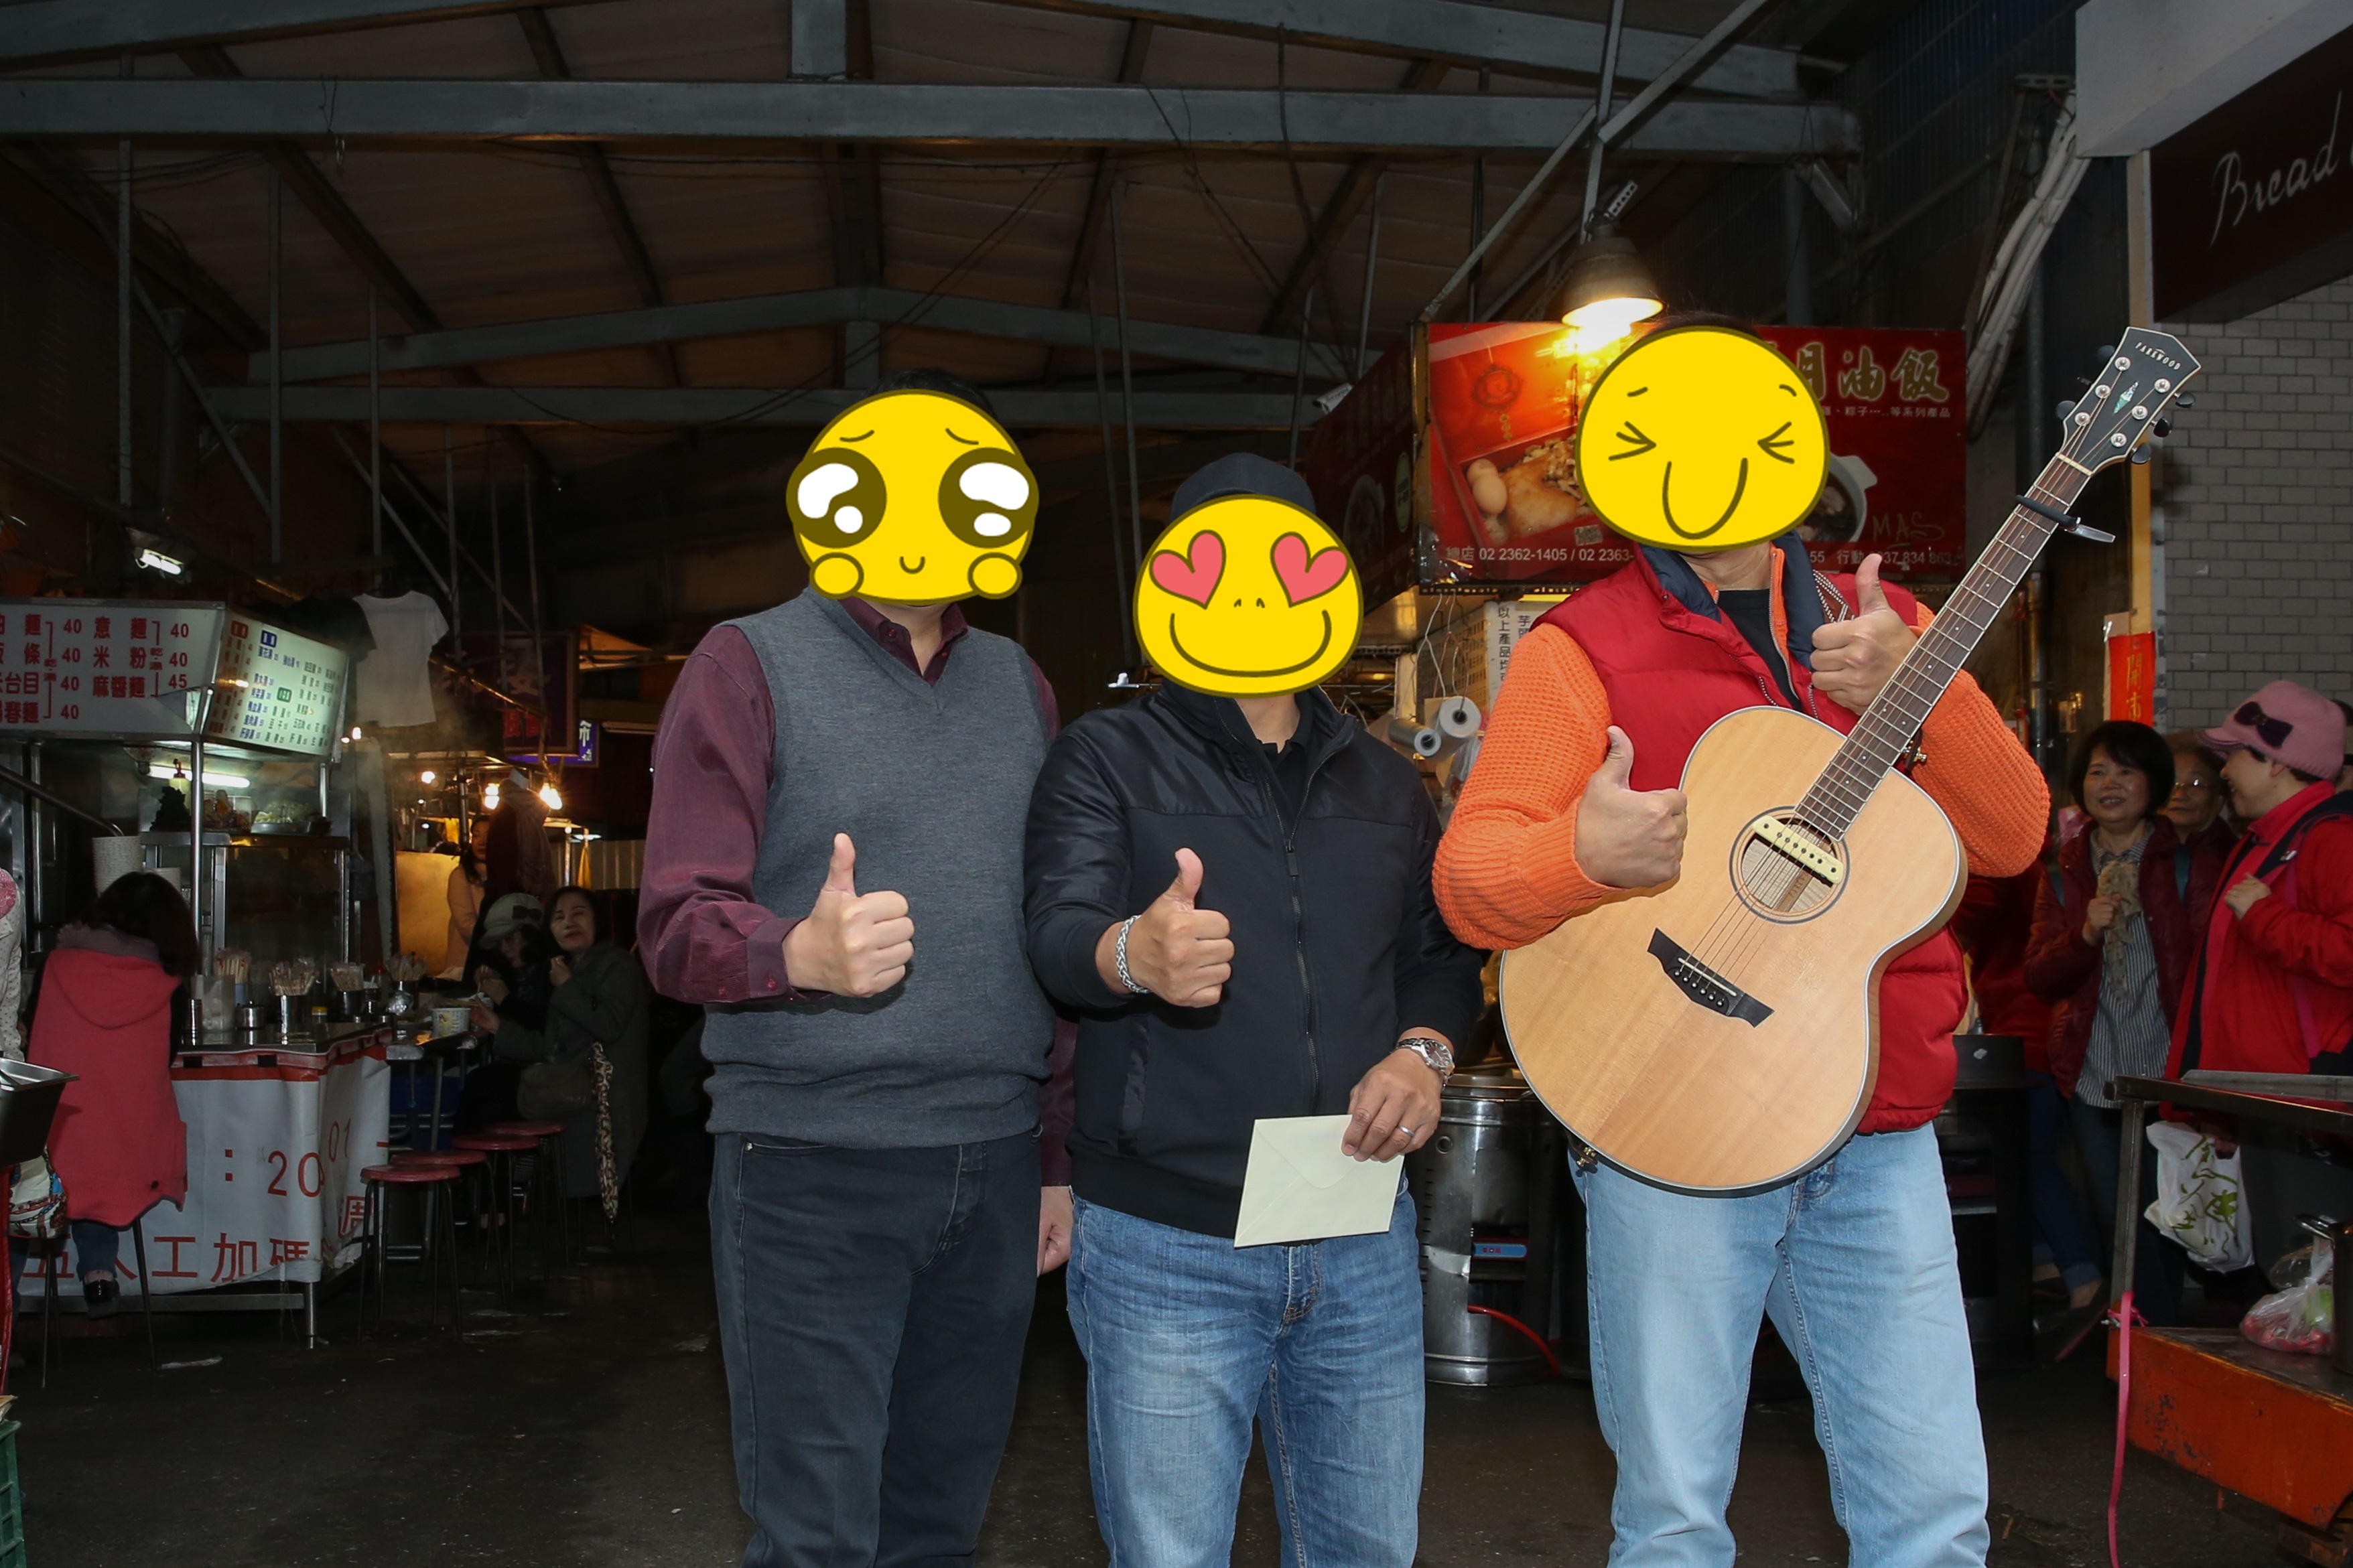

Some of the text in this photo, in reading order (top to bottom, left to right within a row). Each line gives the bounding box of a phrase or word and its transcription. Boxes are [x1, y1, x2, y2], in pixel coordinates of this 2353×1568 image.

[2210, 90, 2343, 251] Bread
[2135, 342, 2181, 370] PARKWOOD
[1769, 340, 1950, 402] 月油飯
[1479, 548, 1495, 561] 02
[1499, 548, 1568, 561] 2362-1405
[1578, 549, 1595, 561] 02
[1599, 549, 1635, 563] 2363-
[1903, 551, 1925, 564] 834
[64, 618, 82, 634] 40
[171, 623, 190, 638] 40
[62, 647, 81, 662] 40
[93, 645, 147, 668] 米粉
[170, 652, 188, 667] 40
[0, 672, 39, 694] 台目
[60, 676, 80, 691] 40
[169, 674, 188, 689] 45
[0, 701, 79, 723] 春麵 40
